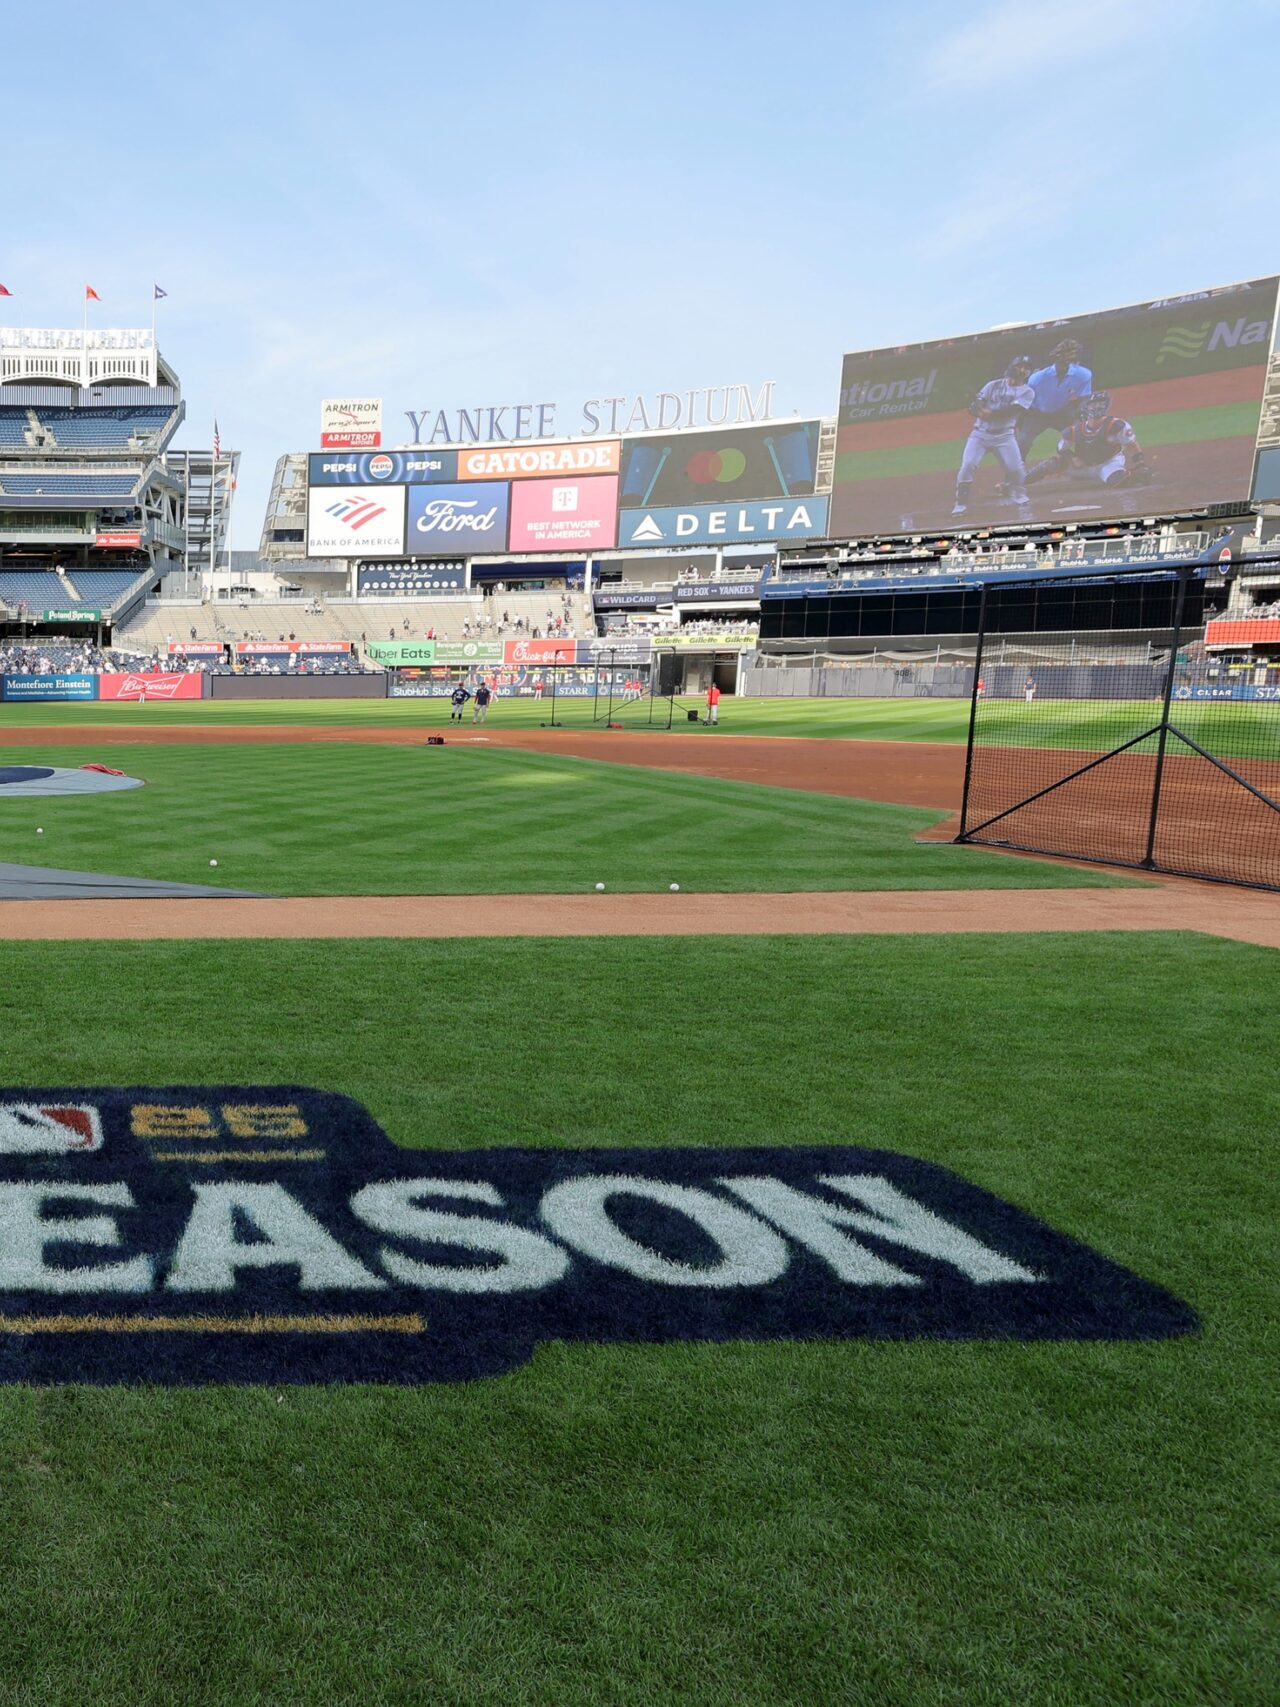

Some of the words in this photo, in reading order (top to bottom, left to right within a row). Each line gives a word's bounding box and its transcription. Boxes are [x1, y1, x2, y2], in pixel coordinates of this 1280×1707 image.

[325, 404, 379, 413] ARMITRON
[404, 403, 556, 445] YANKEE
[581, 381, 776, 436] STADIUM
[849, 407, 875, 418] Car
[879, 398, 928, 415] Rental
[327, 433, 376, 442] ARMITRON
[467, 447, 611, 474] GATORADE
[323, 463, 357, 473] PEPSI
[407, 461, 442, 470] PEPSI
[417, 499, 498, 533] Ford
[676, 505, 813, 536] DELTA
[527, 521, 550, 531] BEST
[551, 519, 601, 530] NETWORK
[535, 530, 545, 539] IN
[546, 528, 592, 539] AMERICA
[309, 538, 337, 547] BANK
[339, 538, 354, 547] OF
[354, 537, 400, 546] AMERICA
[678, 587, 693, 597] RED
[694, 586, 709, 596] SOX
[719, 585, 754, 595] YANKEES
[48, 611, 71, 620] Poland
[71, 611, 96, 621] Spring
[654, 636, 683, 645] Gillette
[689, 636, 718, 644] Gillette
[725, 635, 754, 644] Gillette
[369, 648, 398, 659] Uber
[401, 648, 431, 659] Eats
[7, 680, 54, 689] Montefiore
[55, 679, 91, 689] Einstein
[393, 687, 429, 696] StubHub
[559, 688, 588, 696] STARR
